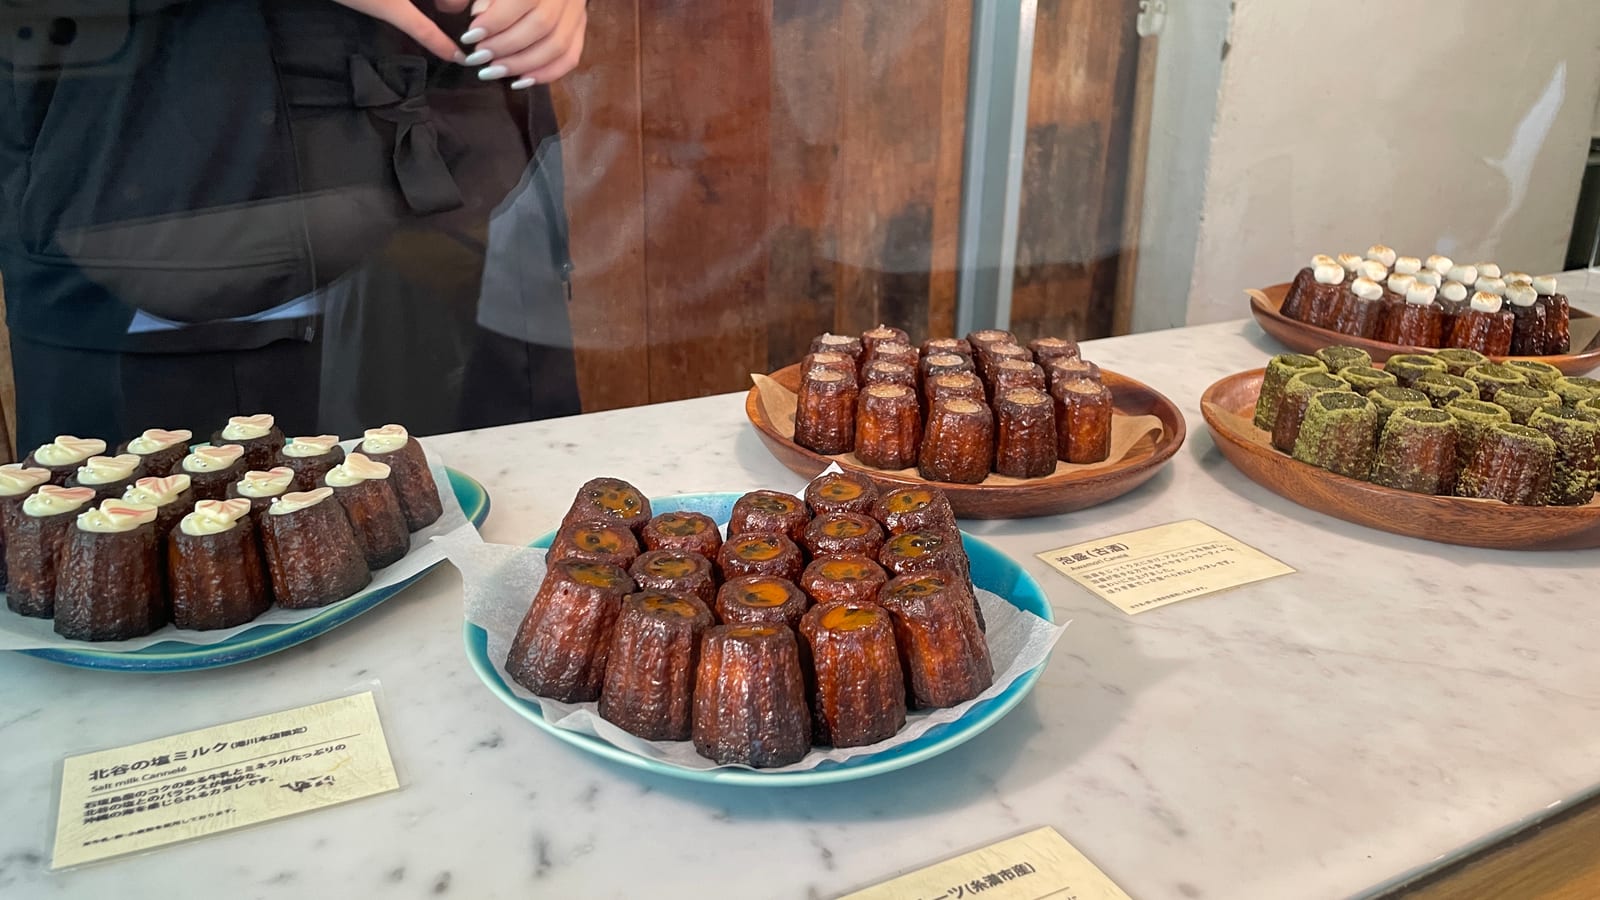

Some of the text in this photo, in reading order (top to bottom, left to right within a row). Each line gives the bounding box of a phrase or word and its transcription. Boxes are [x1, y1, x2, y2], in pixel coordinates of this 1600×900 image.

[91, 781, 112, 793] Salt
[115, 776, 139, 787] milk
[918, 862, 1036, 900] ーツ(糸満市産)
